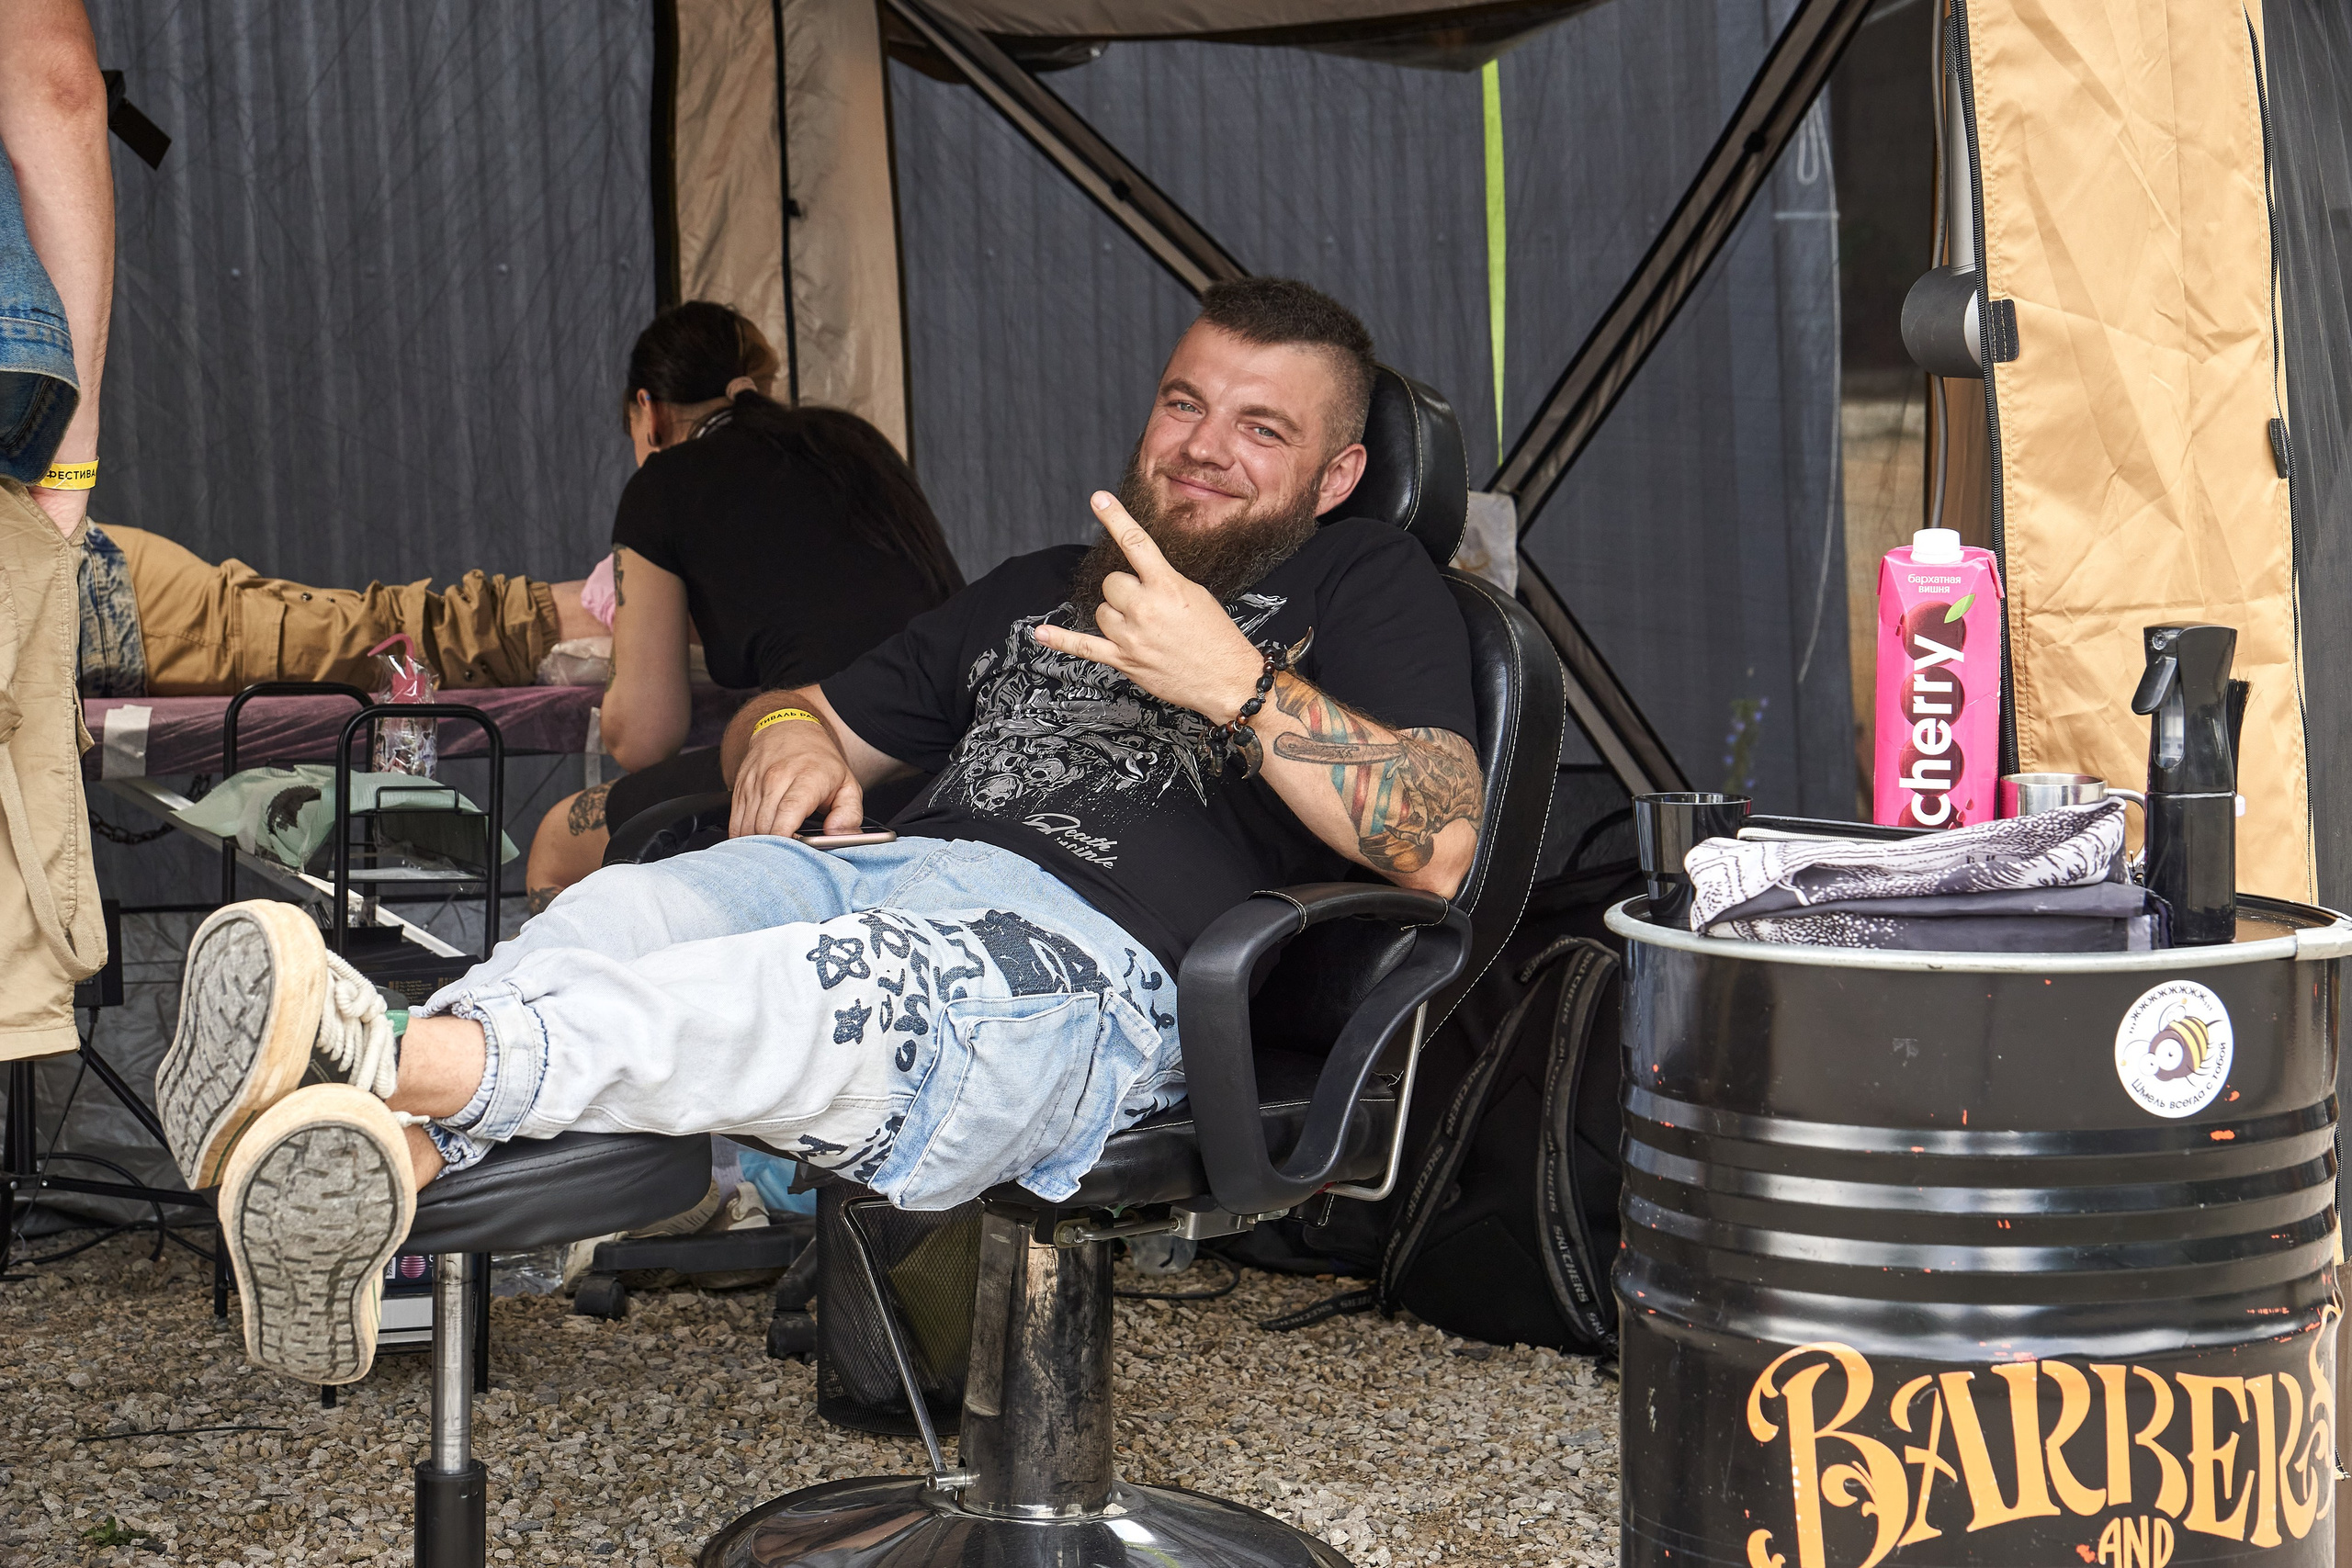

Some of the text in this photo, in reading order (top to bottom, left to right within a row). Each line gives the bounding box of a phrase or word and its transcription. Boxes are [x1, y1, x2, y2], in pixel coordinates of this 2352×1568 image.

[1907, 573, 1962, 585] бархатная
[1918, 585, 1950, 593] вишня
[1899, 634, 1965, 826] cherry
[1022, 813, 1117, 852] Death
[2132, 1042, 2226, 1110] Шмель всегда с тобой
[2098, 1516, 2175, 1568] AND
